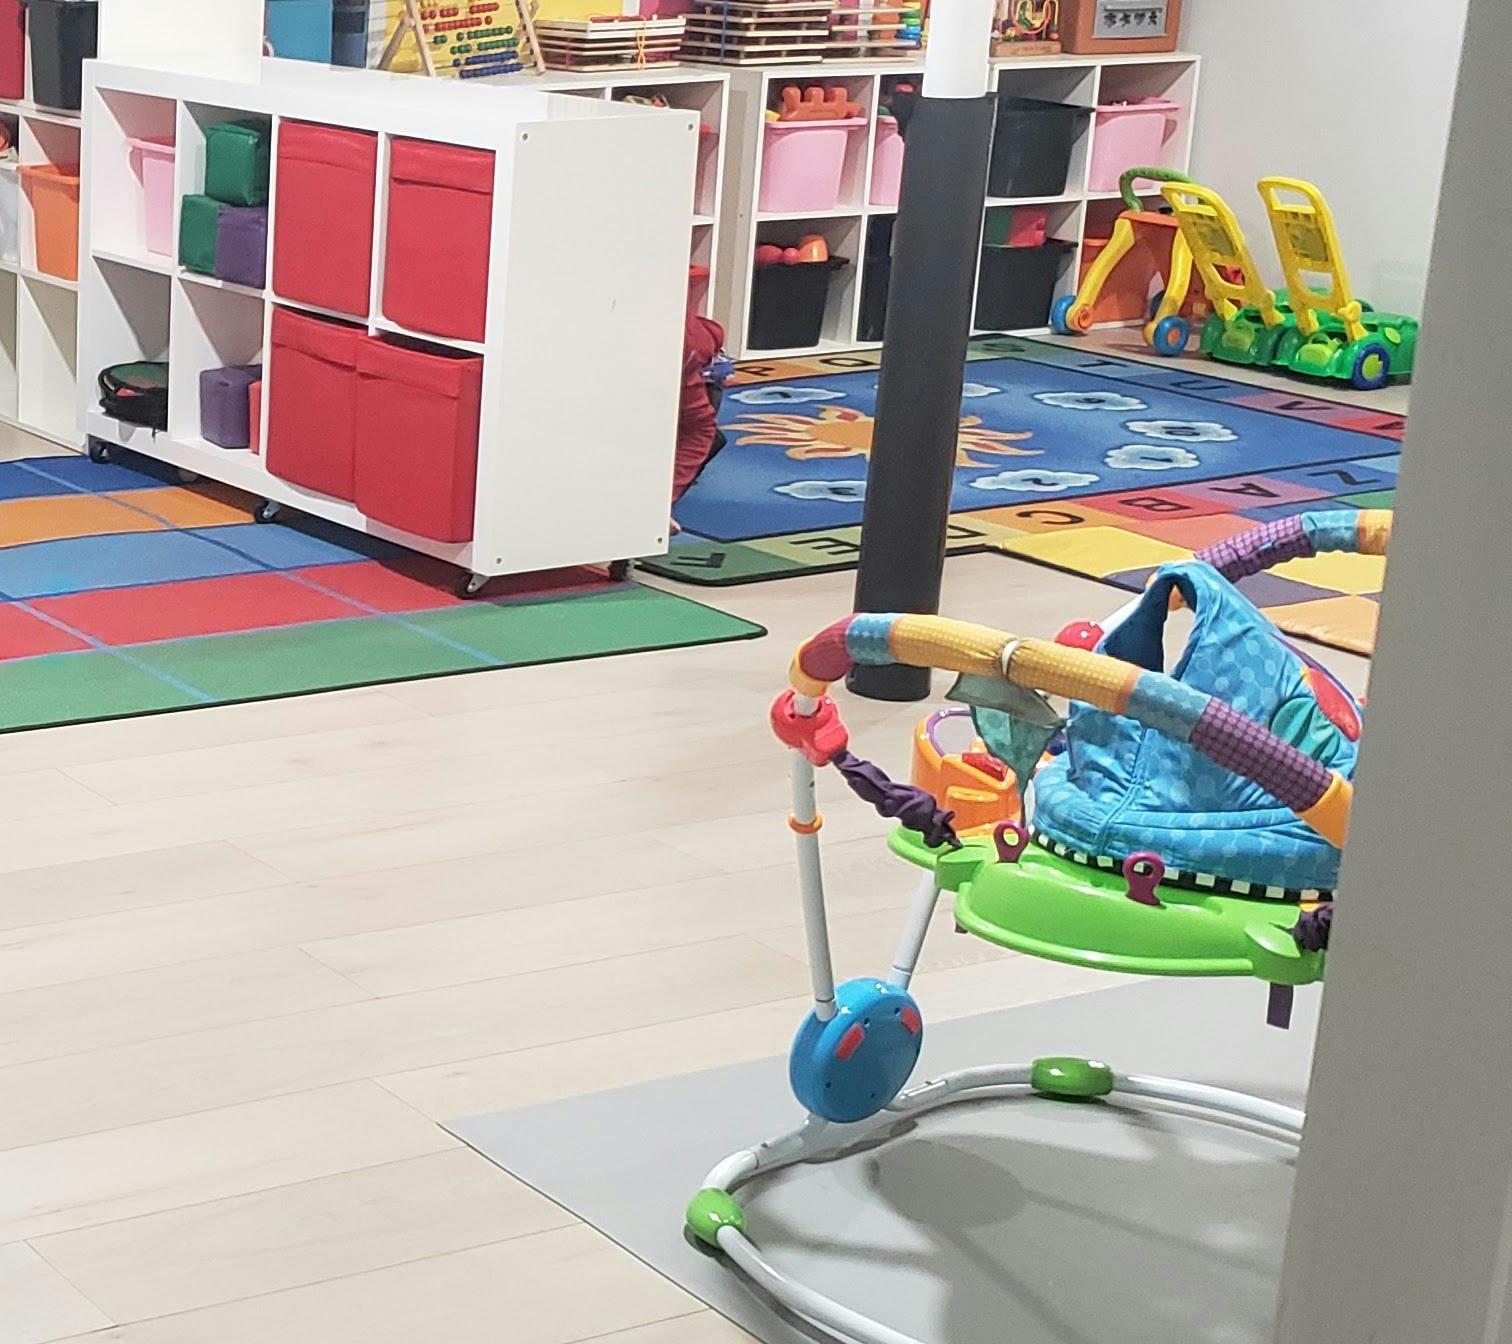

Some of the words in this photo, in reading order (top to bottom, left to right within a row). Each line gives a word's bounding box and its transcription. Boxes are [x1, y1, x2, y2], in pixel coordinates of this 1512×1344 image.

[1078, 359, 1128, 369] T
[1171, 380, 1229, 391] U
[1275, 401, 1331, 411] V
[1307, 470, 1381, 486] Z
[1208, 482, 1281, 498] A
[1117, 497, 1192, 512] B
[1015, 509, 1085, 525] C
[790, 536, 861, 556] E
[670, 552, 727, 568] F
